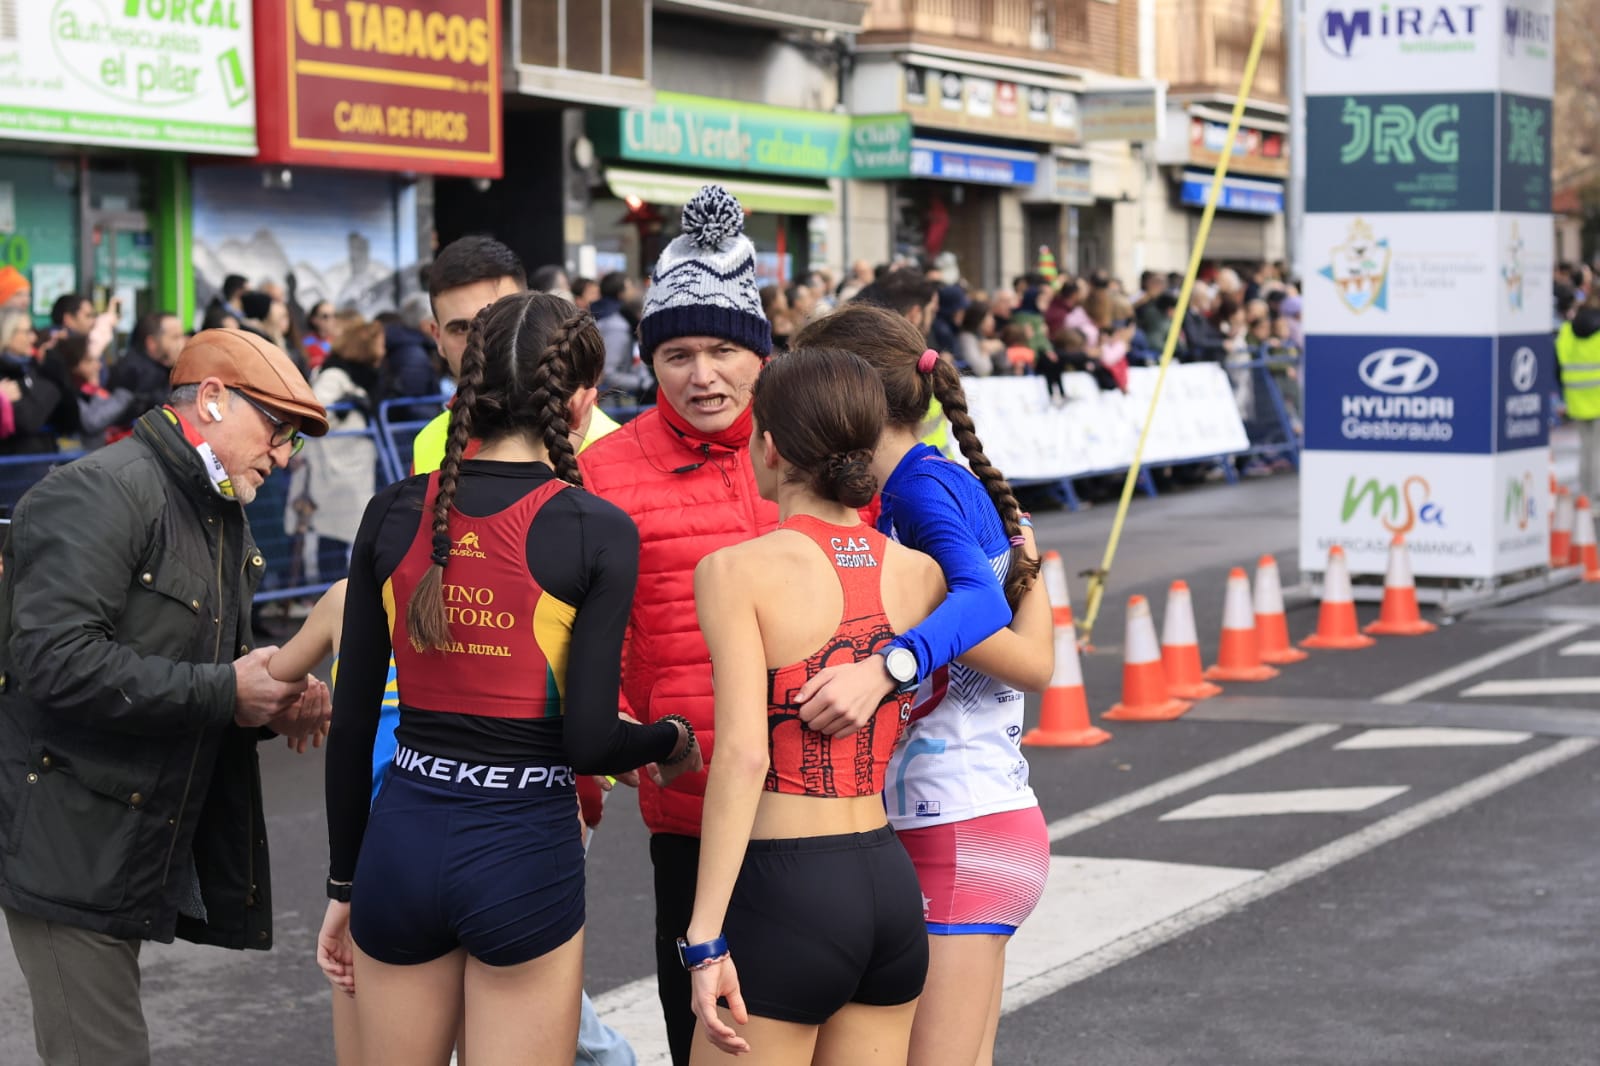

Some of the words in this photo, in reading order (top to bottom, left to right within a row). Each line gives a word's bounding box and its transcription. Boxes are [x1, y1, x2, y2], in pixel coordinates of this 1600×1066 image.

[345, 1, 489, 65] TABACOS
[100, 51, 127, 86] el
[137, 55, 201, 100] pilar
[334, 100, 385, 135] CAVA
[386, 105, 411, 138] DE
[412, 108, 468, 142] PUROS
[625, 104, 683, 156] Club
[684, 109, 752, 163] Verde
[1341, 98, 1459, 164] JRG
[1341, 396, 1454, 418] HYUNDAI
[1340, 416, 1453, 440] Gestorauto
[835, 553, 877, 568] SEGOVIA
[445, 606, 515, 630] TORO
[468, 643, 511, 657] RURAL
